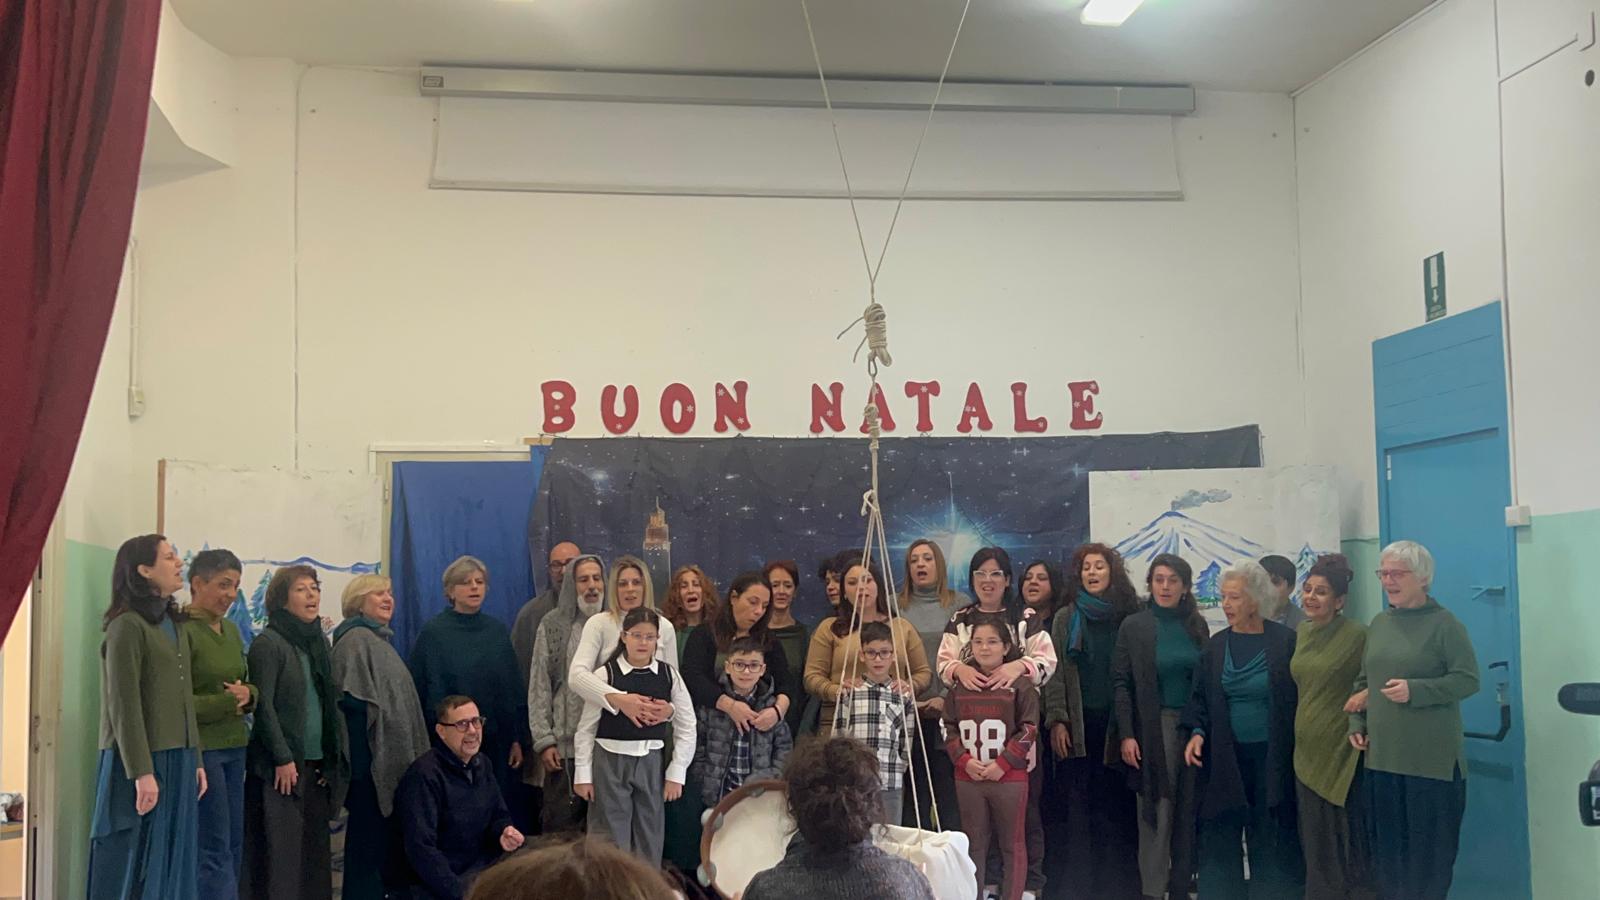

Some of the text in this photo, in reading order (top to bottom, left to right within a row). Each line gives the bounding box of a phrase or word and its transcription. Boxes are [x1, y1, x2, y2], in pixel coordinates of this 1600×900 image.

[541, 380, 1103, 434] BUON NATALE
[958, 719, 1006, 765] 88
